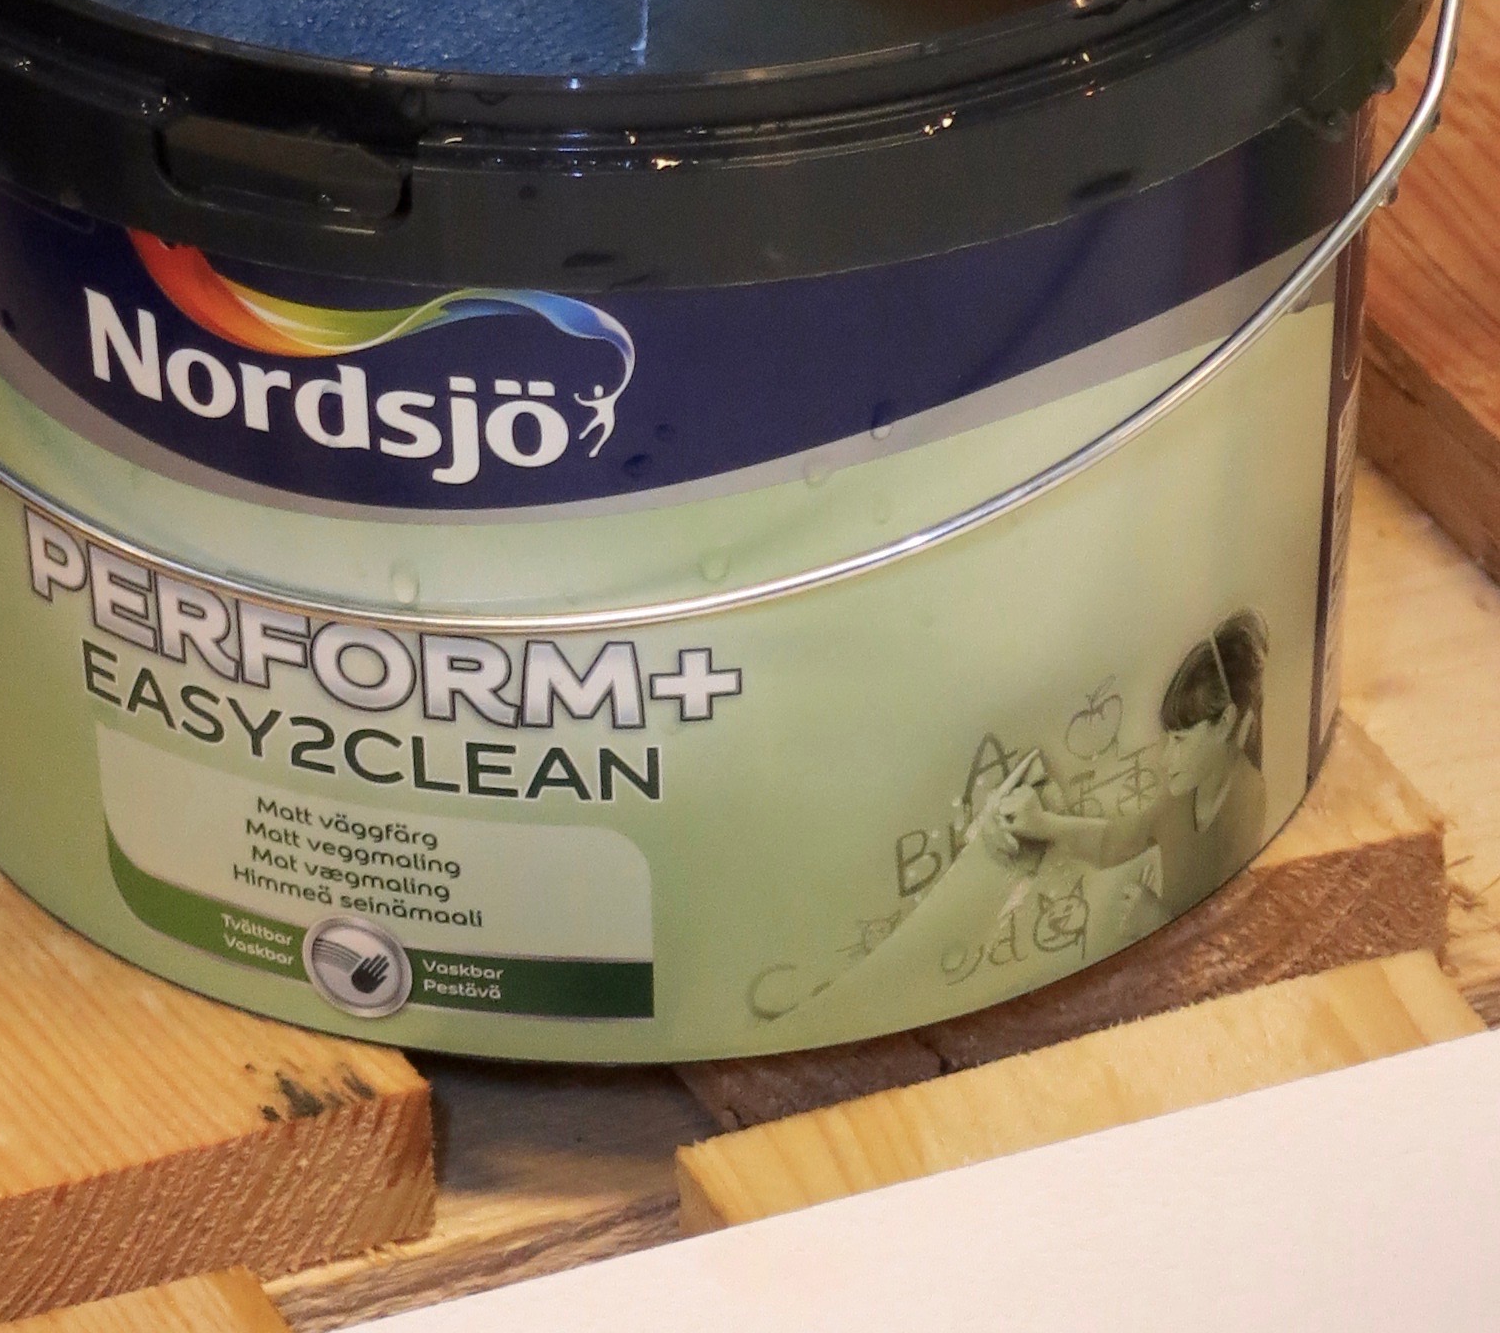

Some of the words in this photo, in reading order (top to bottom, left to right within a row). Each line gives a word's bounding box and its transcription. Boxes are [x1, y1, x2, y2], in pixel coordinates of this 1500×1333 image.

[83, 286, 570, 485] Nordsjö
[23, 505, 742, 730] PERFORM+
[81, 637, 661, 802] EASY2CLEAN
[245, 818, 301, 848] Matt
[307, 837, 462, 879] veggmaling
[257, 796, 313, 825] Matt
[319, 814, 439, 851] väggfärg
[232, 863, 333, 906] Himmeä
[340, 892, 484, 928] seinämaali
[251, 844, 298, 874] Mat
[304, 863, 451, 904] vægmaling
[220, 912, 293, 947] Tvättbar
[223, 933, 296, 967] Vaskbar
[421, 958, 504, 981] Vaskbar
[422, 977, 503, 1000] Pestävä
